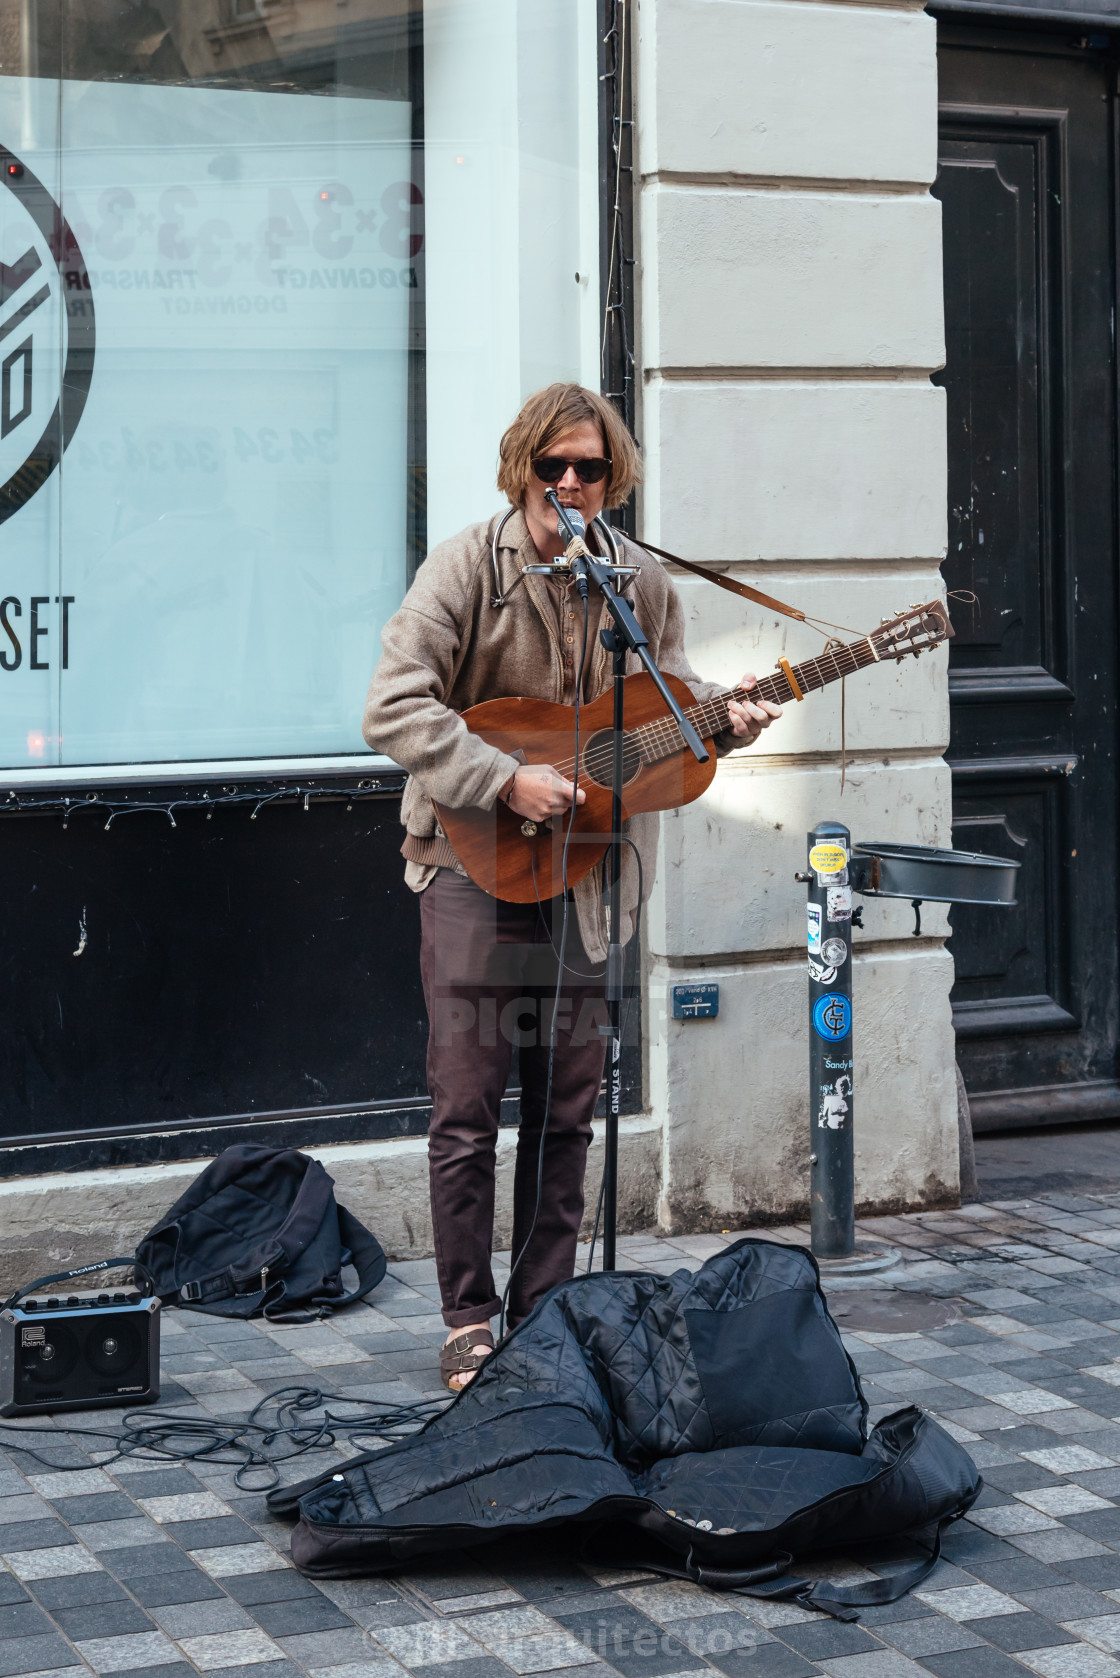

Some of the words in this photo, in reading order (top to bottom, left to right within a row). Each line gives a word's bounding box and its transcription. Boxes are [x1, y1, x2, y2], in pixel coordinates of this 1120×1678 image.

[0, 596, 75, 671] SET
[825, 1060, 848, 1071] Sandy
[611, 1069, 620, 1114] STAND
[68, 1262, 108, 1276] Roland
[21, 1340, 46, 1348] Roland
